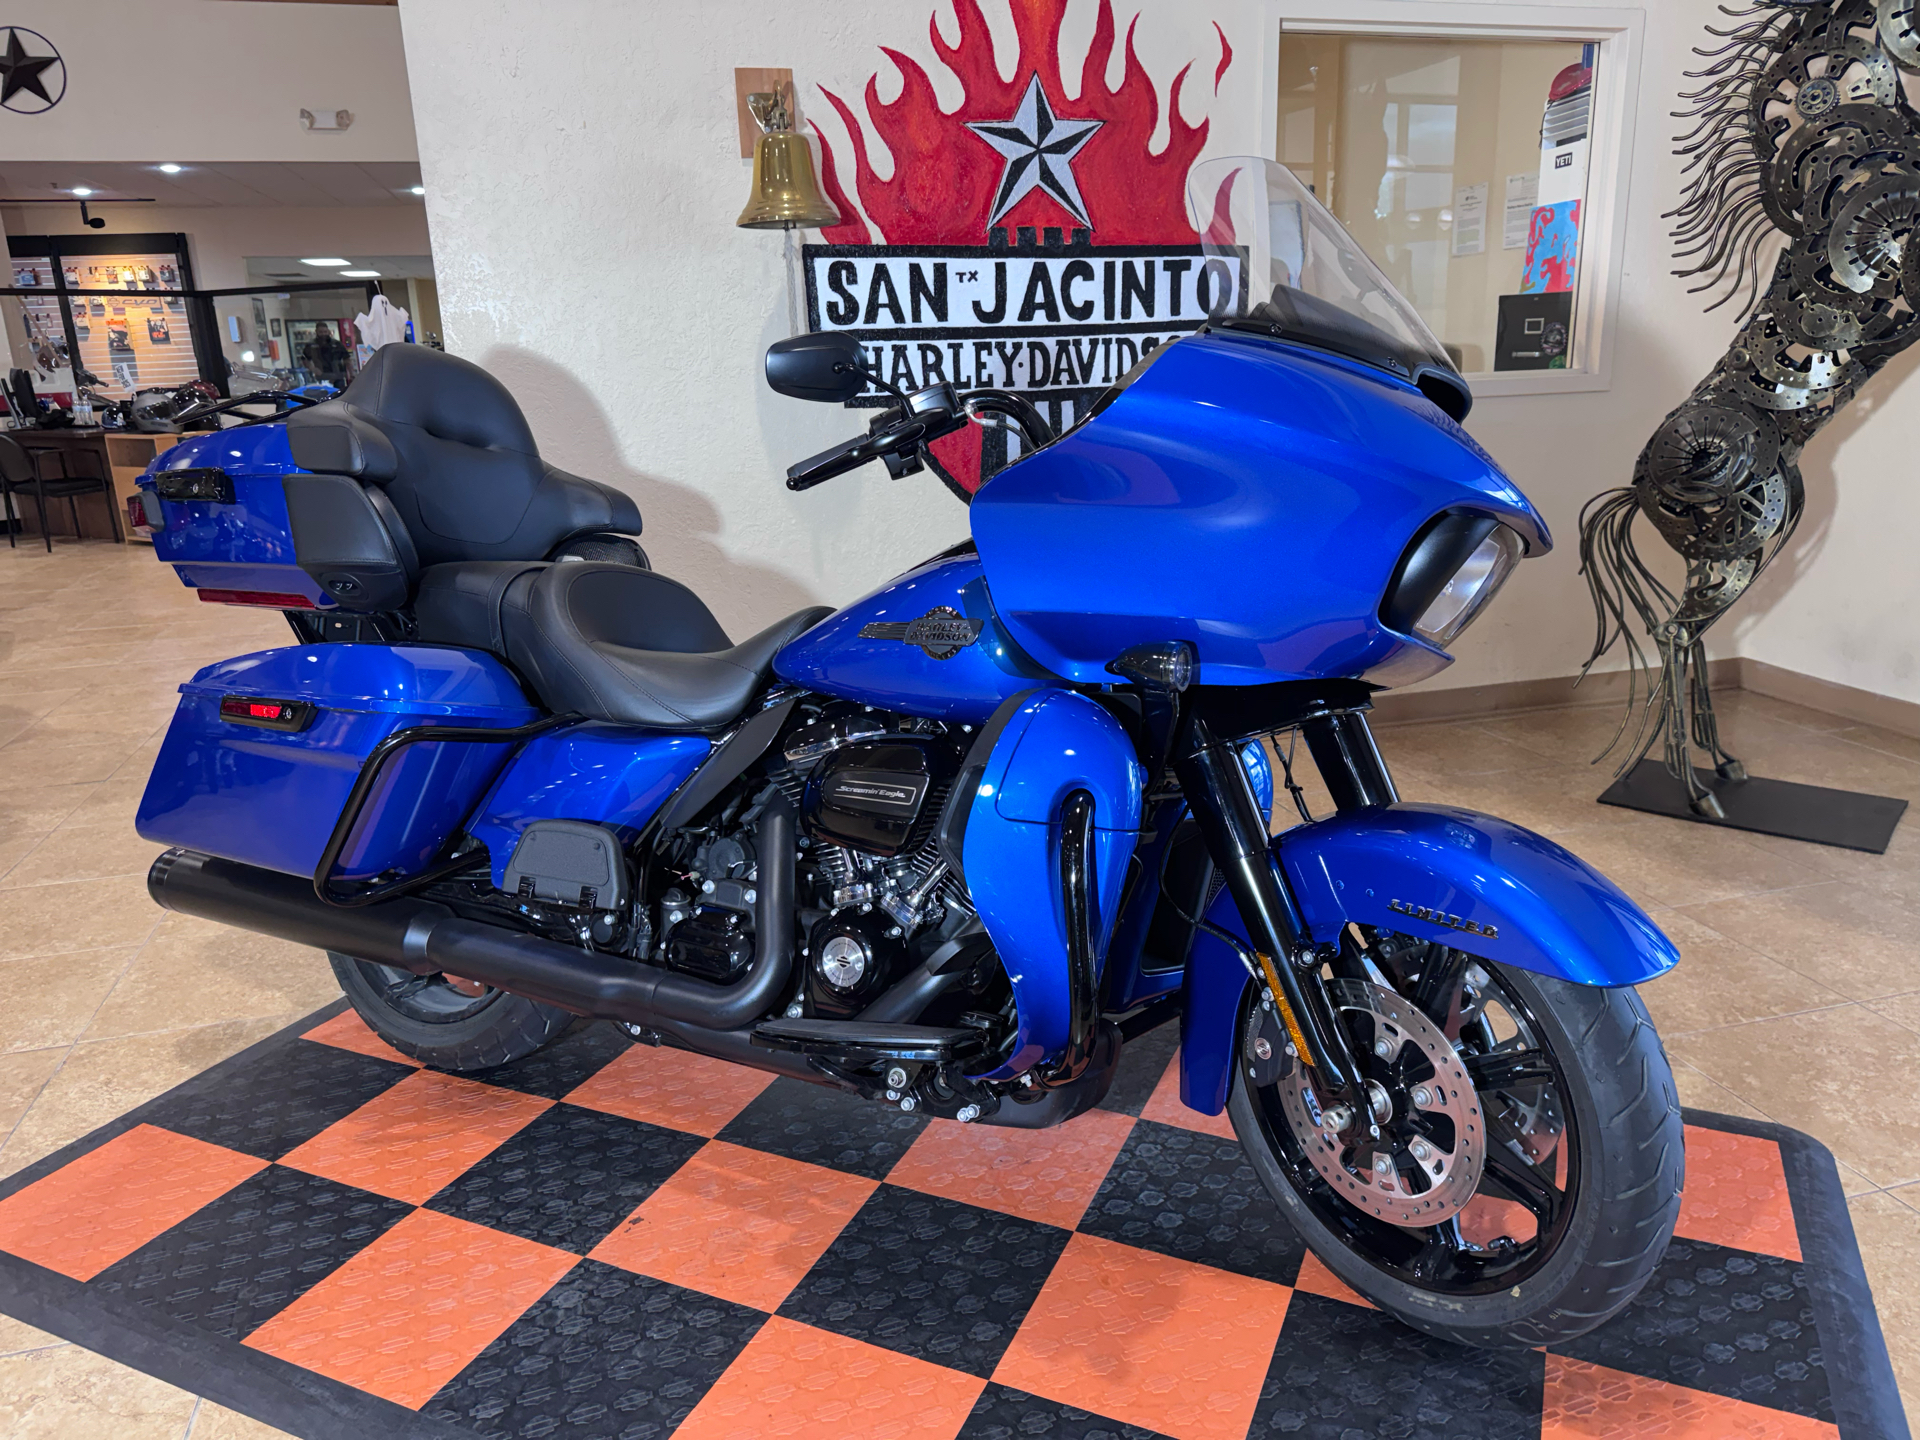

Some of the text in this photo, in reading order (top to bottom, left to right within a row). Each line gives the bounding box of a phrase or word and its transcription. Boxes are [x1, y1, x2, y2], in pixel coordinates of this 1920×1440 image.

[1556, 154, 1571, 167] YETI
[826, 258, 1232, 326] SAN TX JACINTO
[909, 631, 972, 642] DAVIDSON
[878, 789, 906, 798] Eagle
[1387, 898, 1499, 940] LIMITED
